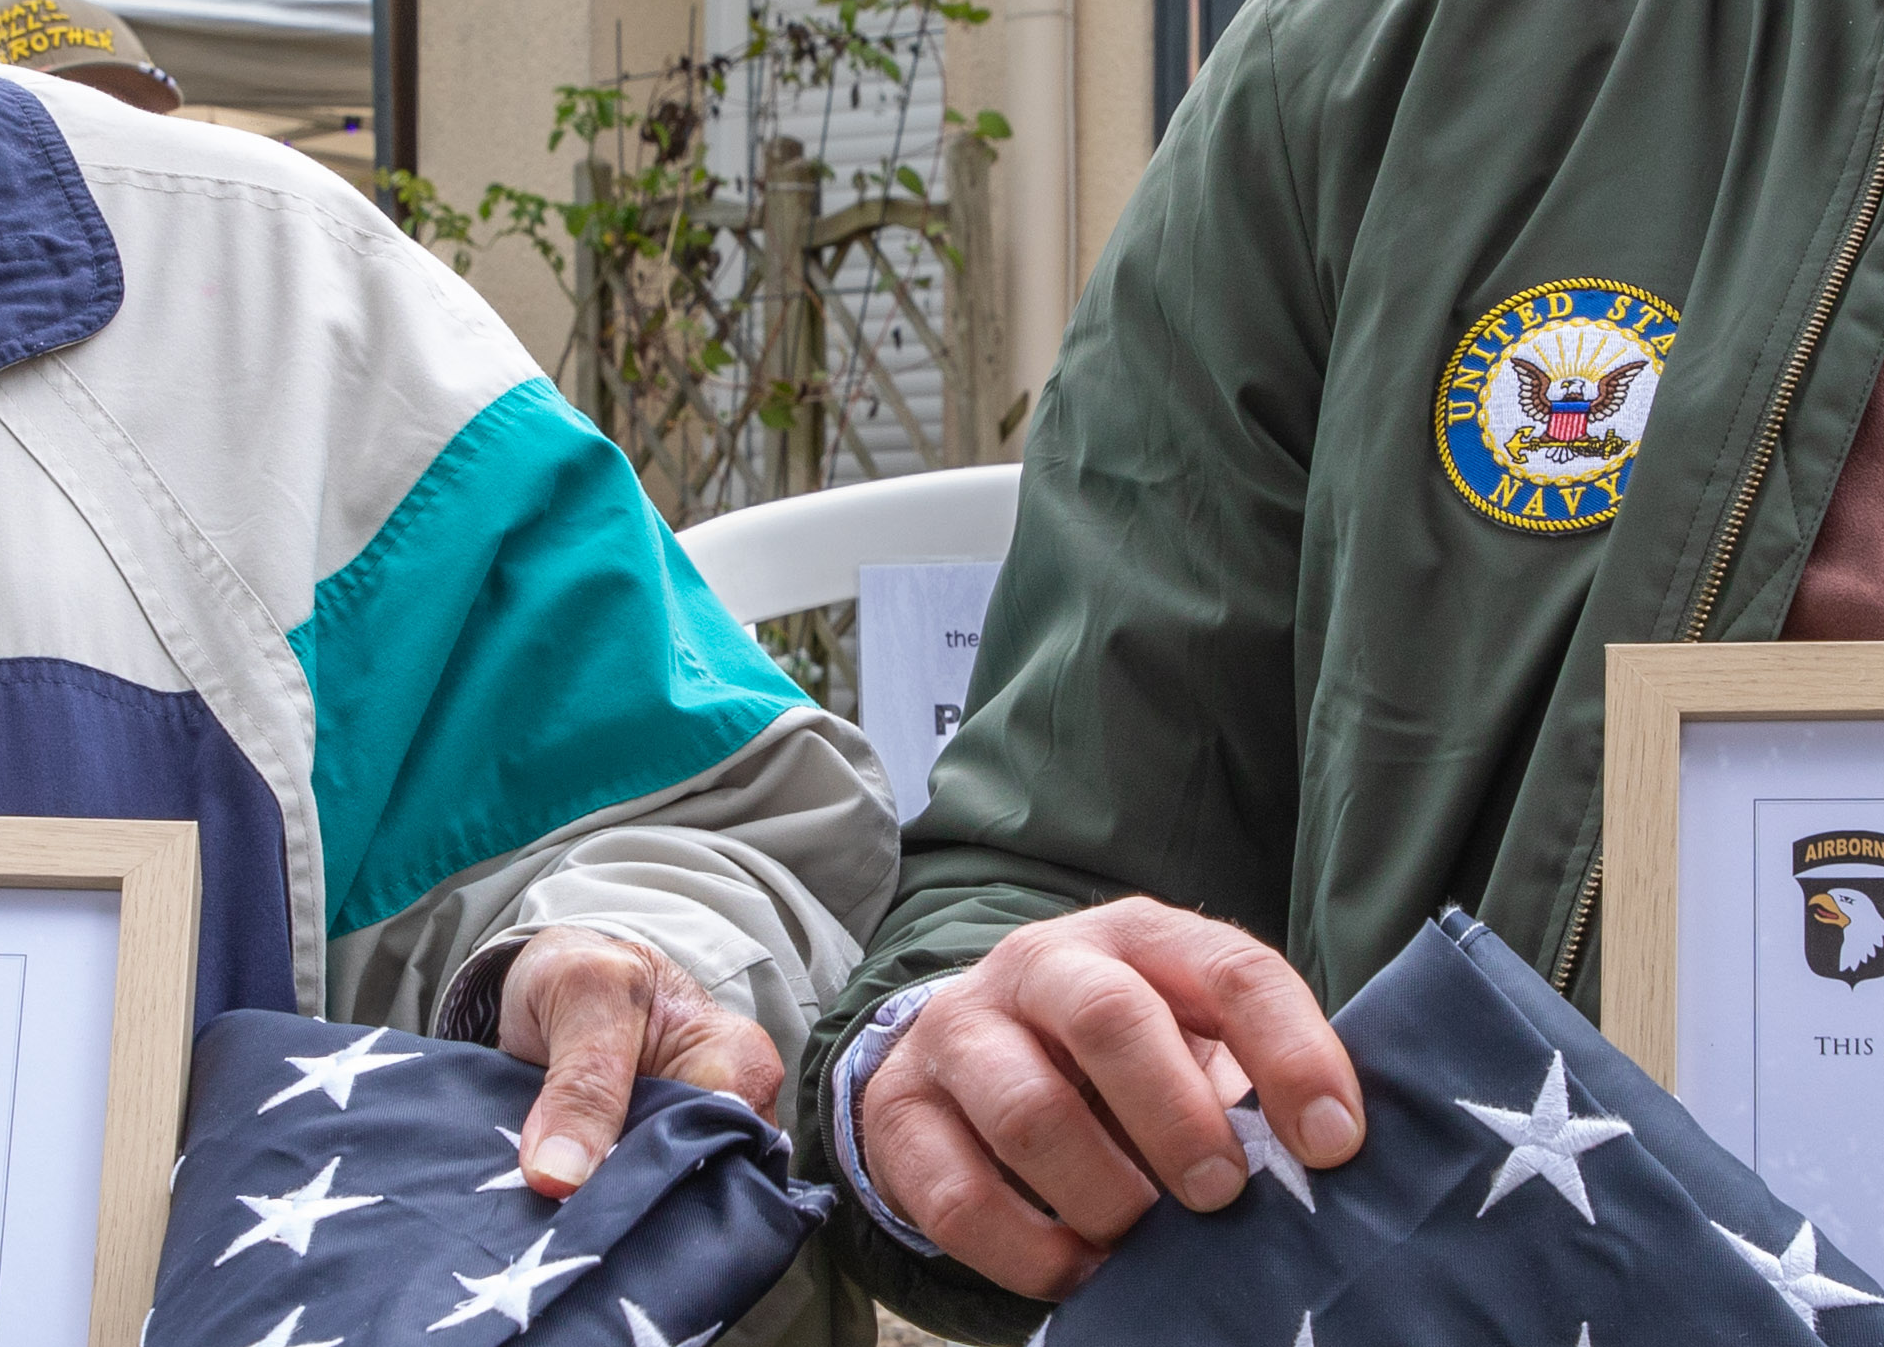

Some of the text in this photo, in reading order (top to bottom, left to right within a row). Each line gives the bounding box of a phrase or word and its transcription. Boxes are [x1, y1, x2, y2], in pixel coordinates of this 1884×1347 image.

[1448, 292, 1677, 425] UNITED STA
[1489, 472, 1623, 517] NAVY
[945, 630, 980, 648] the
[1814, 1036, 1874, 1056] THIS
